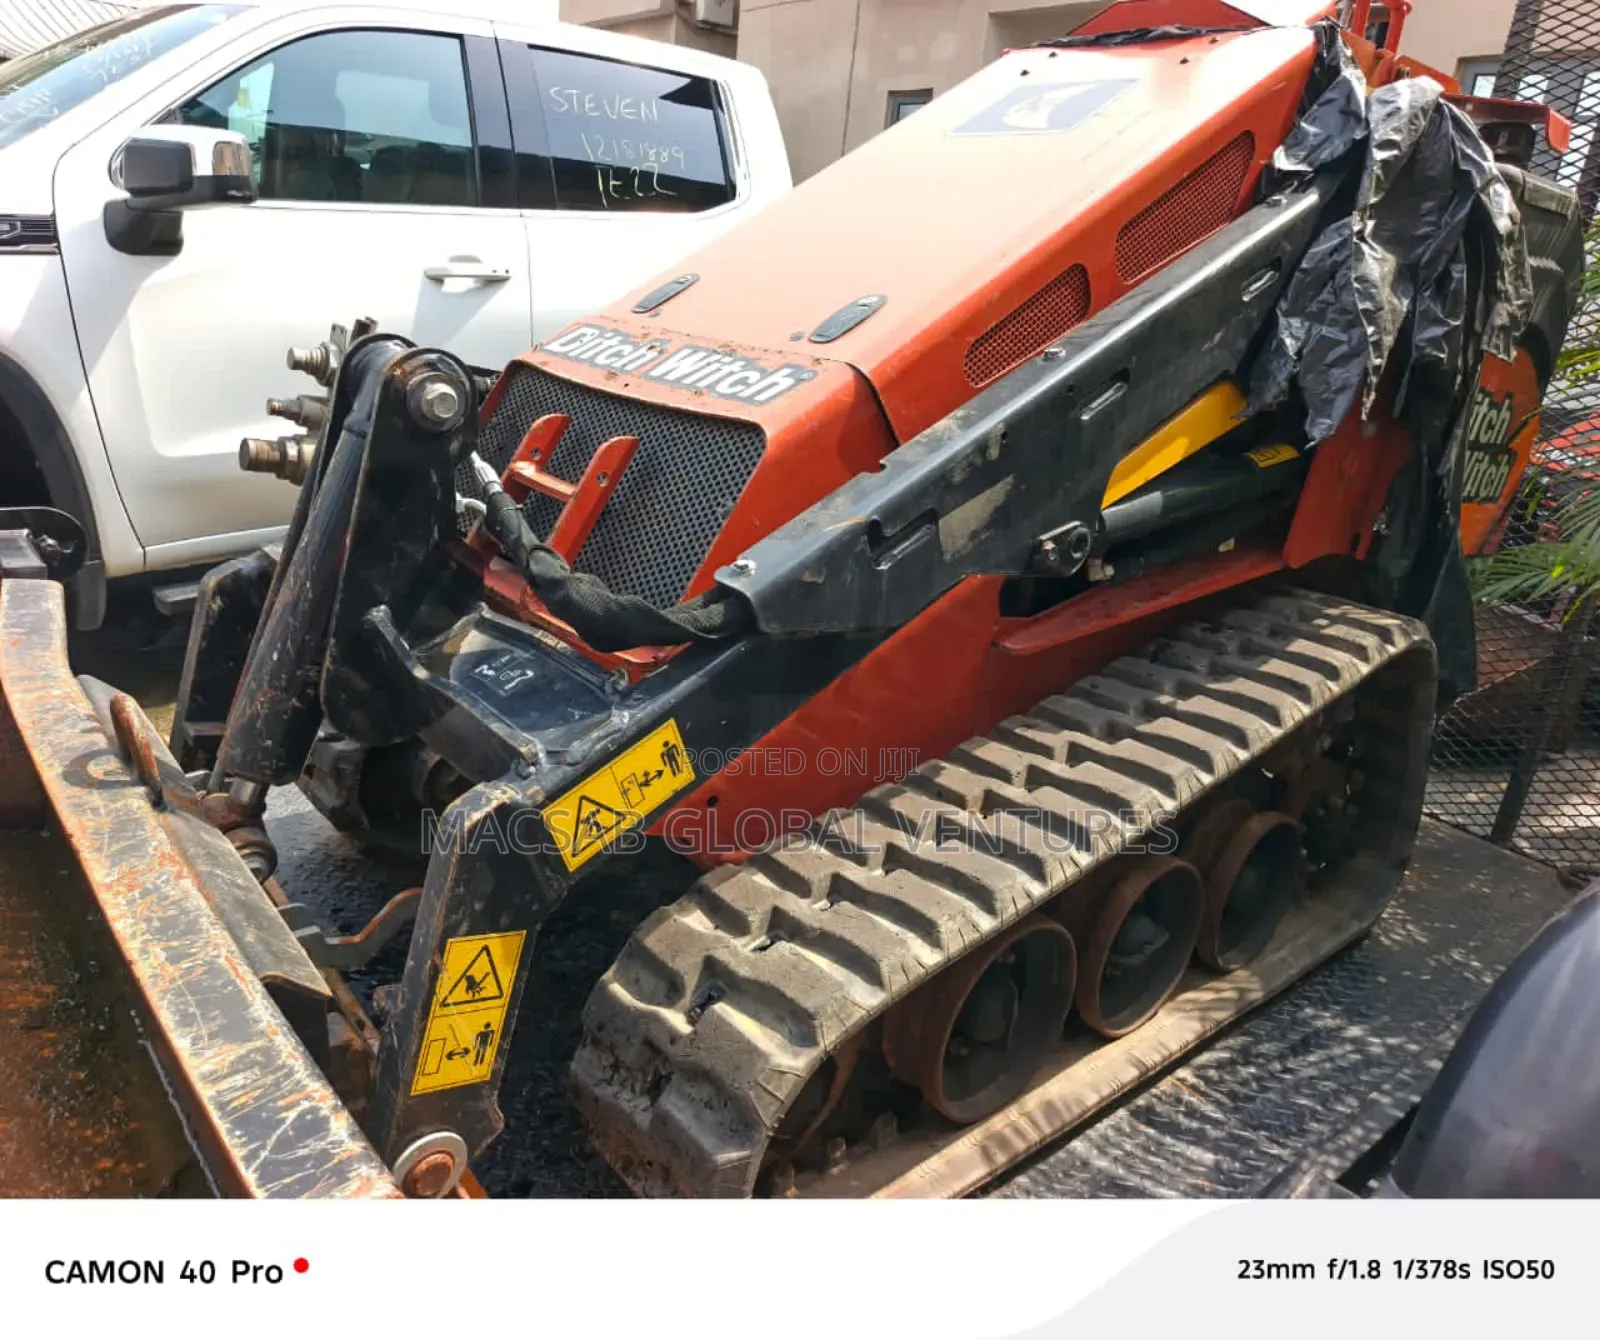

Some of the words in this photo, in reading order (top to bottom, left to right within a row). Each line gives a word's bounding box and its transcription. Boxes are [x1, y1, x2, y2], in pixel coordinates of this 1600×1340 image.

[549, 86, 658, 124] STEVEN
[543, 326, 664, 371] Ditch
[649, 347, 797, 402] Witch
[1469, 393, 1512, 444] itch
